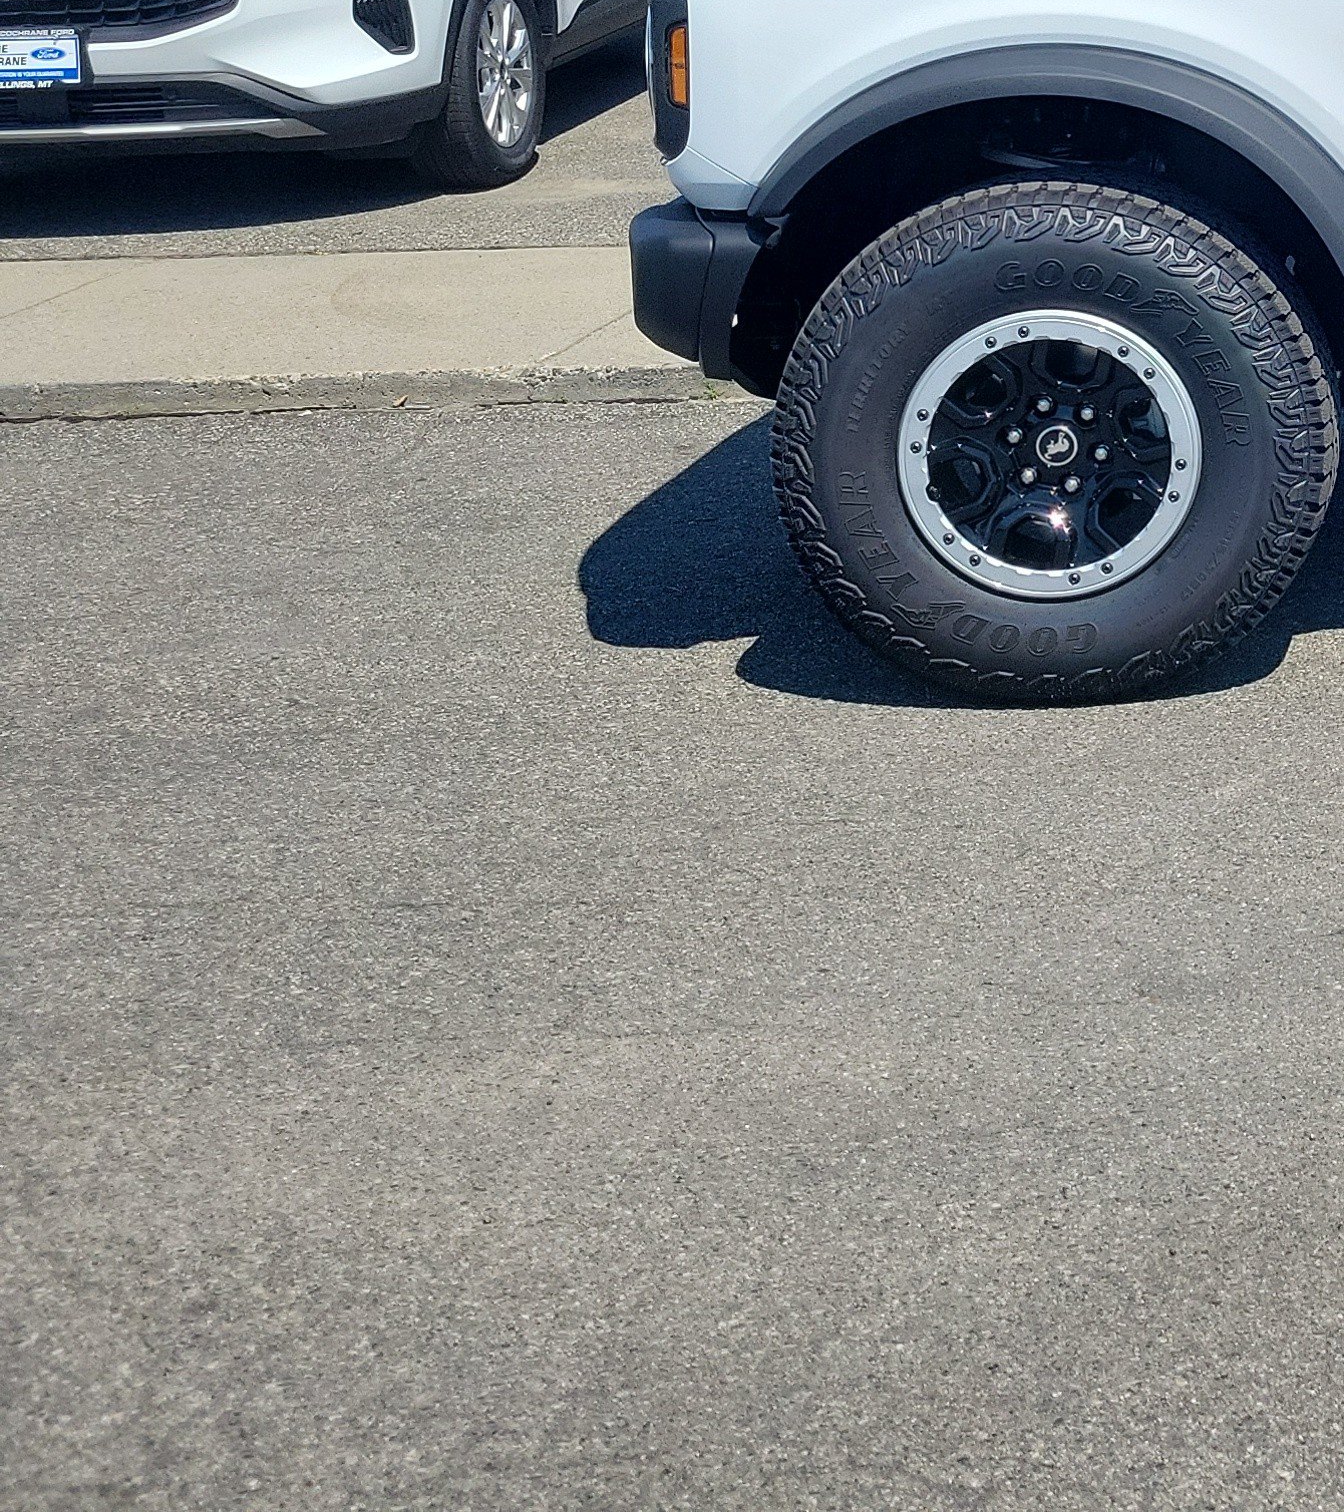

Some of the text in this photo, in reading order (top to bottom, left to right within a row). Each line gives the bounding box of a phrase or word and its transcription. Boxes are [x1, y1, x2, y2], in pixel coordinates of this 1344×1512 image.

[51, 28, 75, 37] FORD
[37, 48, 60, 59] Ford
[37, 80, 54, 88] MT
[994, 258, 1251, 446] GOODYEAR
[839, 470, 1099, 657] GOODYEAR
